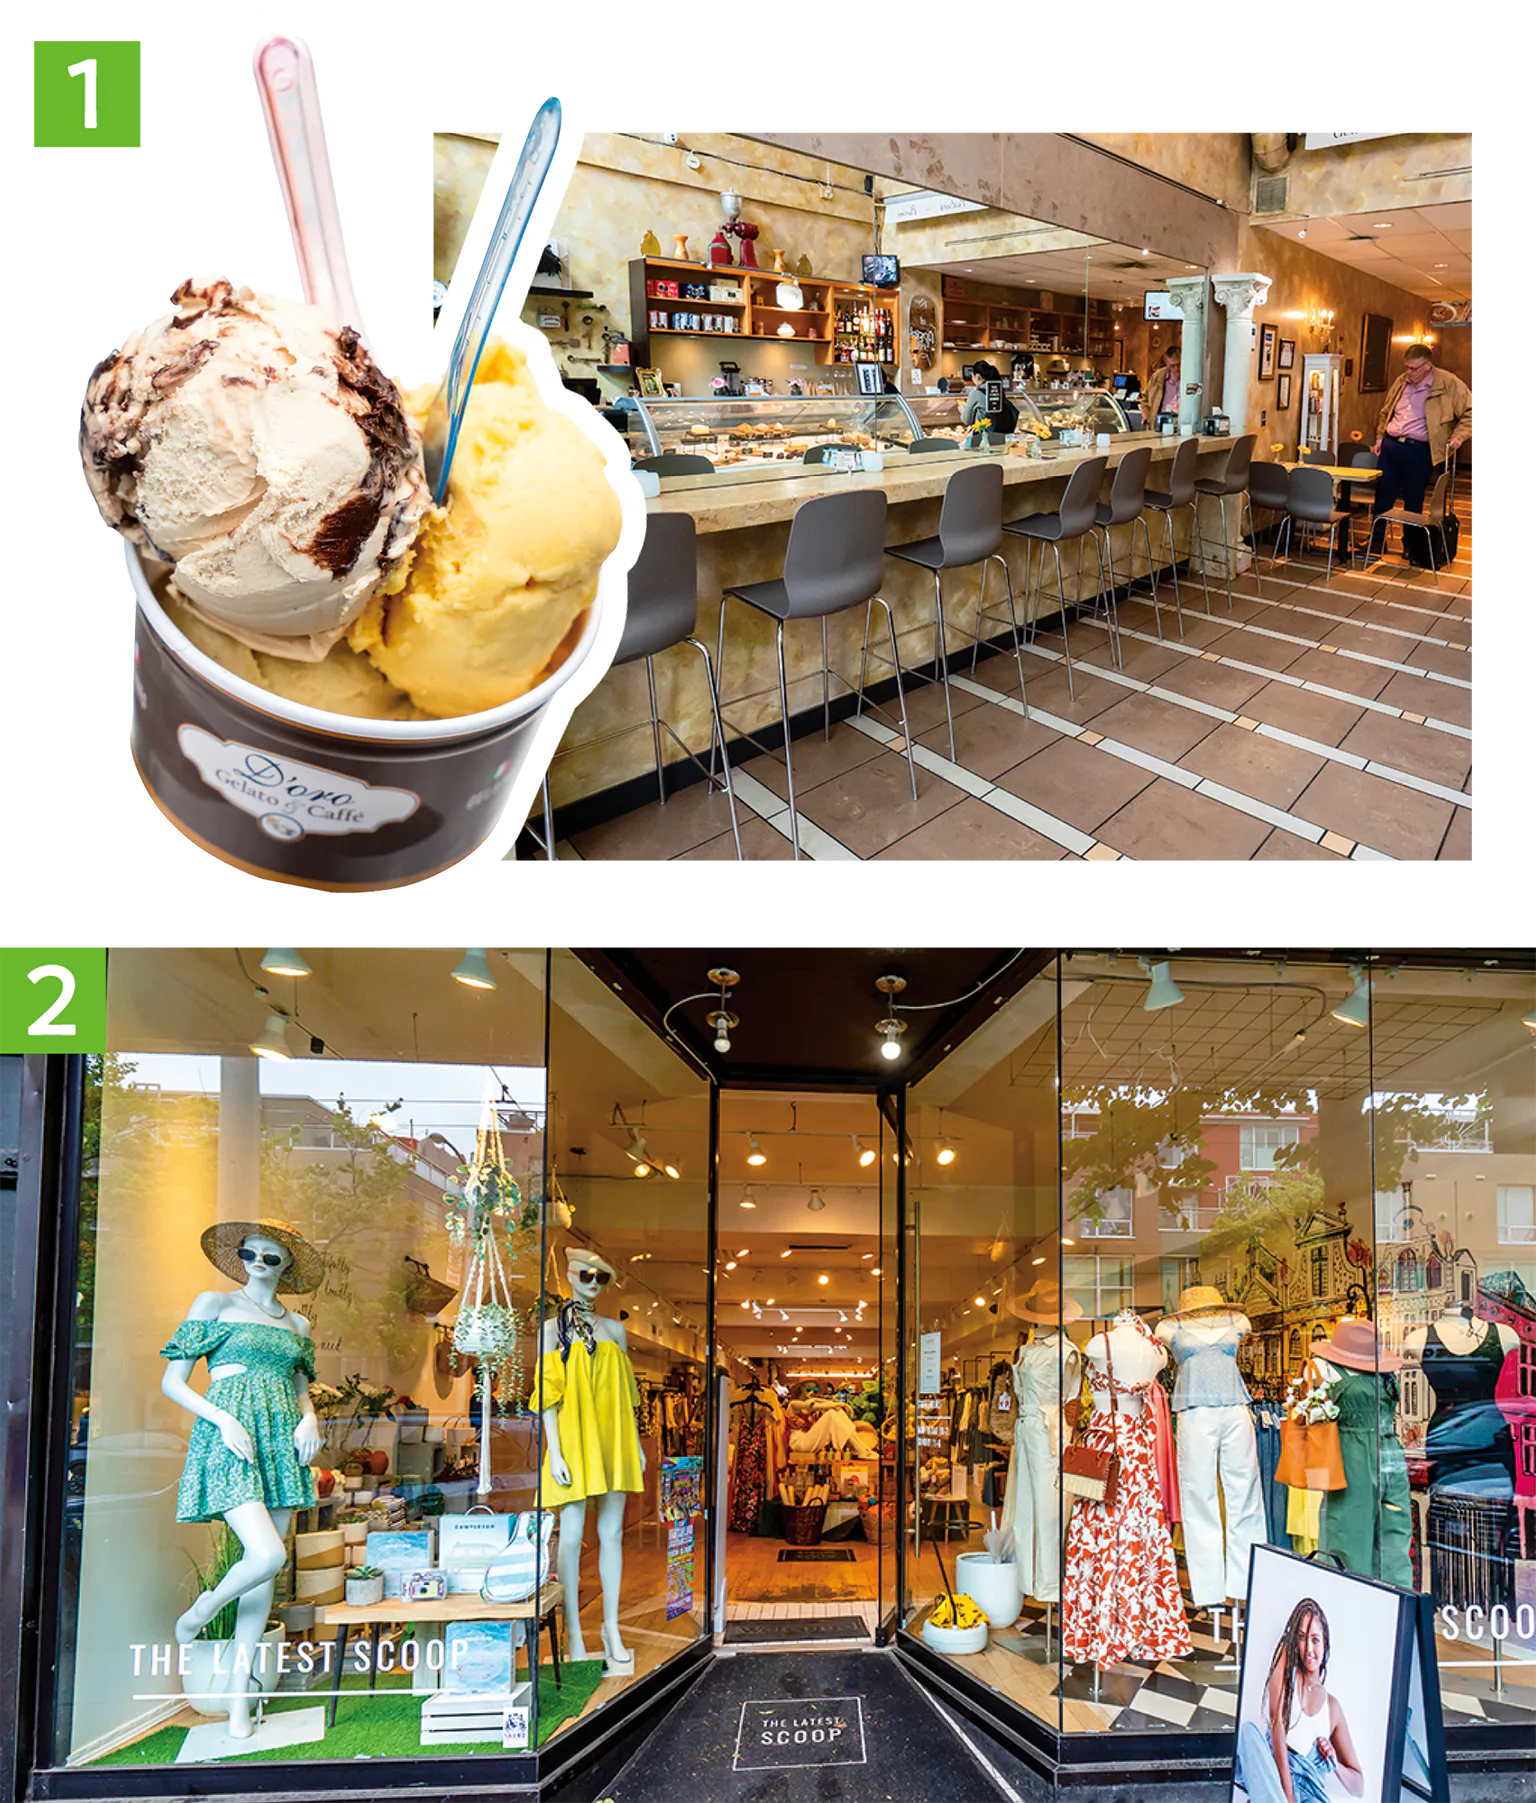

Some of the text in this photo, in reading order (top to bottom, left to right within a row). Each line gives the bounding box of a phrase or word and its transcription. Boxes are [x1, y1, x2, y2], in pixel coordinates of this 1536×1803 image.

[215, 768, 279, 807] Gelato
[232, 753, 355, 806] D'oro
[1442, 1604, 1536, 1640] SCOO
[129, 1638, 470, 1676] THE LATEST SCOOP
[760, 1728, 841, 1745] SCOOP
[763, 1716, 840, 1728] THE LATEST
